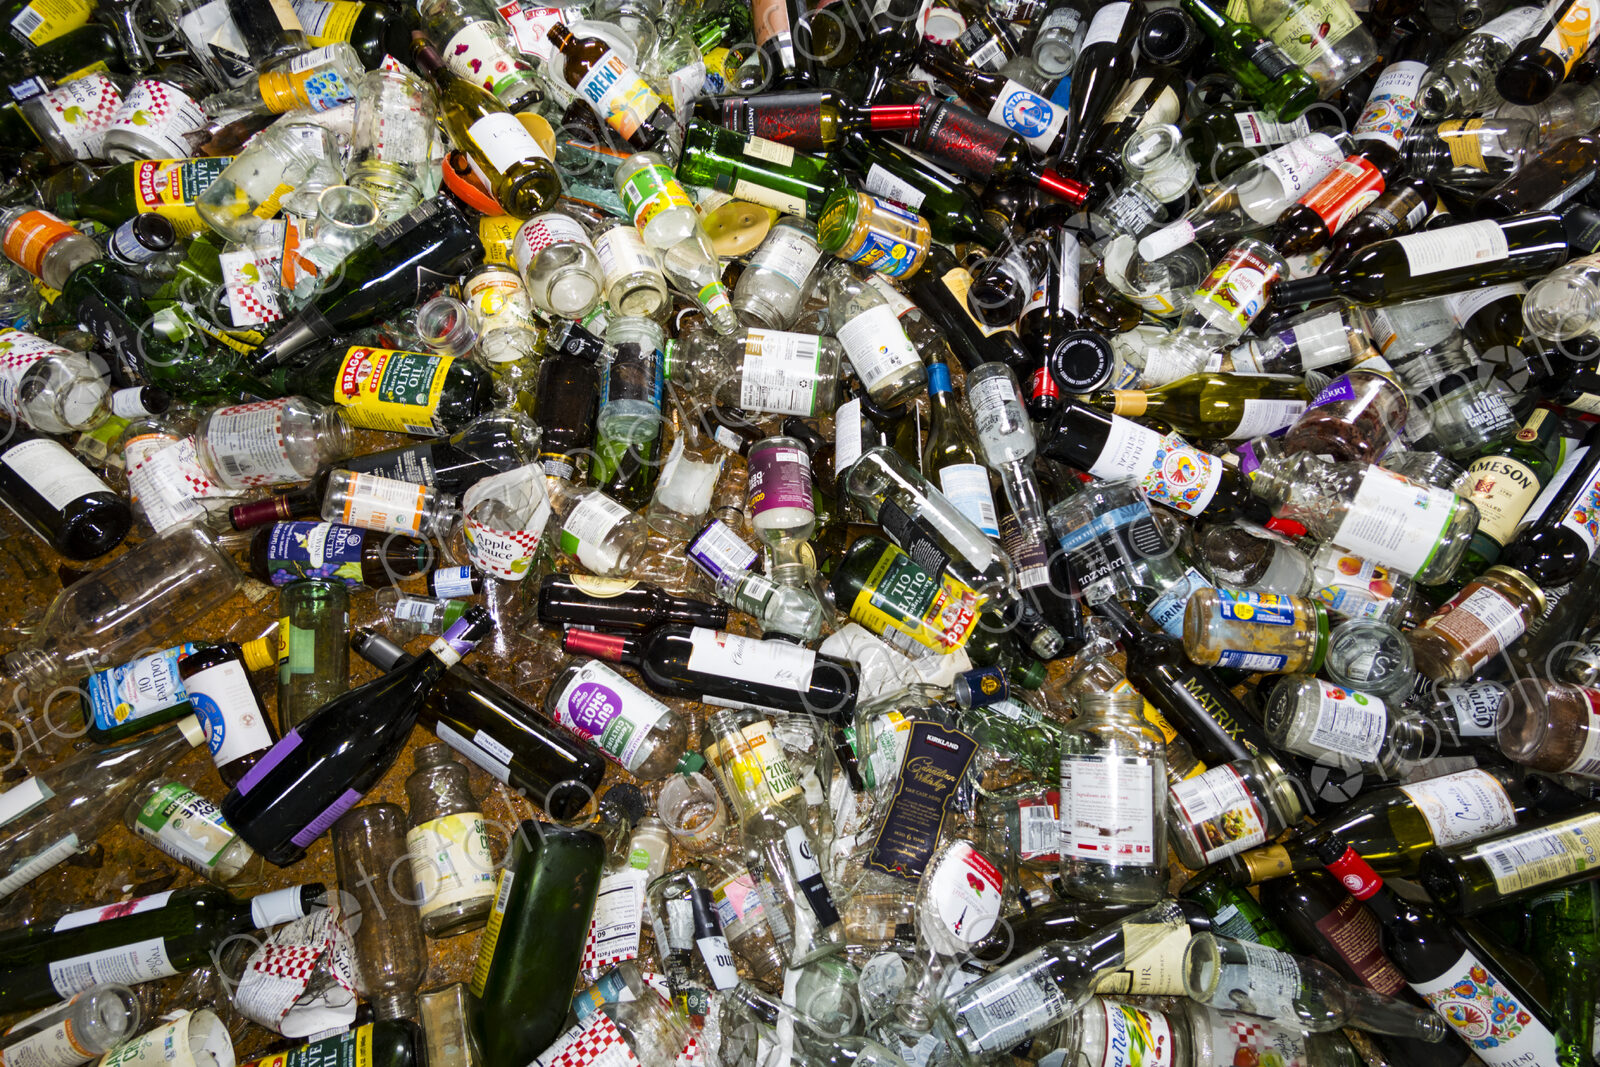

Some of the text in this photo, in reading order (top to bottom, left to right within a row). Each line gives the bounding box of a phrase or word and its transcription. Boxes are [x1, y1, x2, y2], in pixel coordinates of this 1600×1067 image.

[584, 65, 617, 103] BREW
[929, 108, 947, 137] APOTHIC
[1005, 92, 1031, 127] FAT TIRE
[141, 163, 156, 202] BRAGG
[343, 350, 365, 391] BRAGG
[371, 357, 385, 389] ORGANIC
[392, 358, 403, 377] Virgin
[395, 357, 416, 396] OLIVE
[408, 366, 424, 388] OIL
[1468, 461, 1532, 489] AMESON
[314, 539, 322, 558] WINE
[326, 526, 338, 559] SELECTED
[334, 528, 352, 555] EDEN
[476, 533, 513, 551] Apple
[478, 542, 513, 561] Sauce
[1077, 558, 1125, 587] LUNAZUL
[891, 574, 911, 599] OIL
[900, 571, 926, 616] OLIVE
[138, 676, 150, 693] Oil
[149, 657, 168, 702] Cod Liver
[583, 691, 607, 727] SHOT
[594, 703, 615, 728] GUT
[1183, 676, 1245, 741] MATRIX
[212, 725, 223, 751] FAT
[605, 719, 626, 752] CULTURE
[926, 734, 960, 751] KIRKLAND
[906, 756, 958, 782] Canadian
[913, 772, 947, 792] Whisky
[769, 776, 798, 795] ANTA
[906, 832, 912, 841] 6
[597, 930, 606, 939] 60
[613, 923, 636, 932] Calories
[150, 946, 163, 967] TWO
[597, 945, 637, 958] Nutrition Facts
[146, 958, 163, 977] VINES
